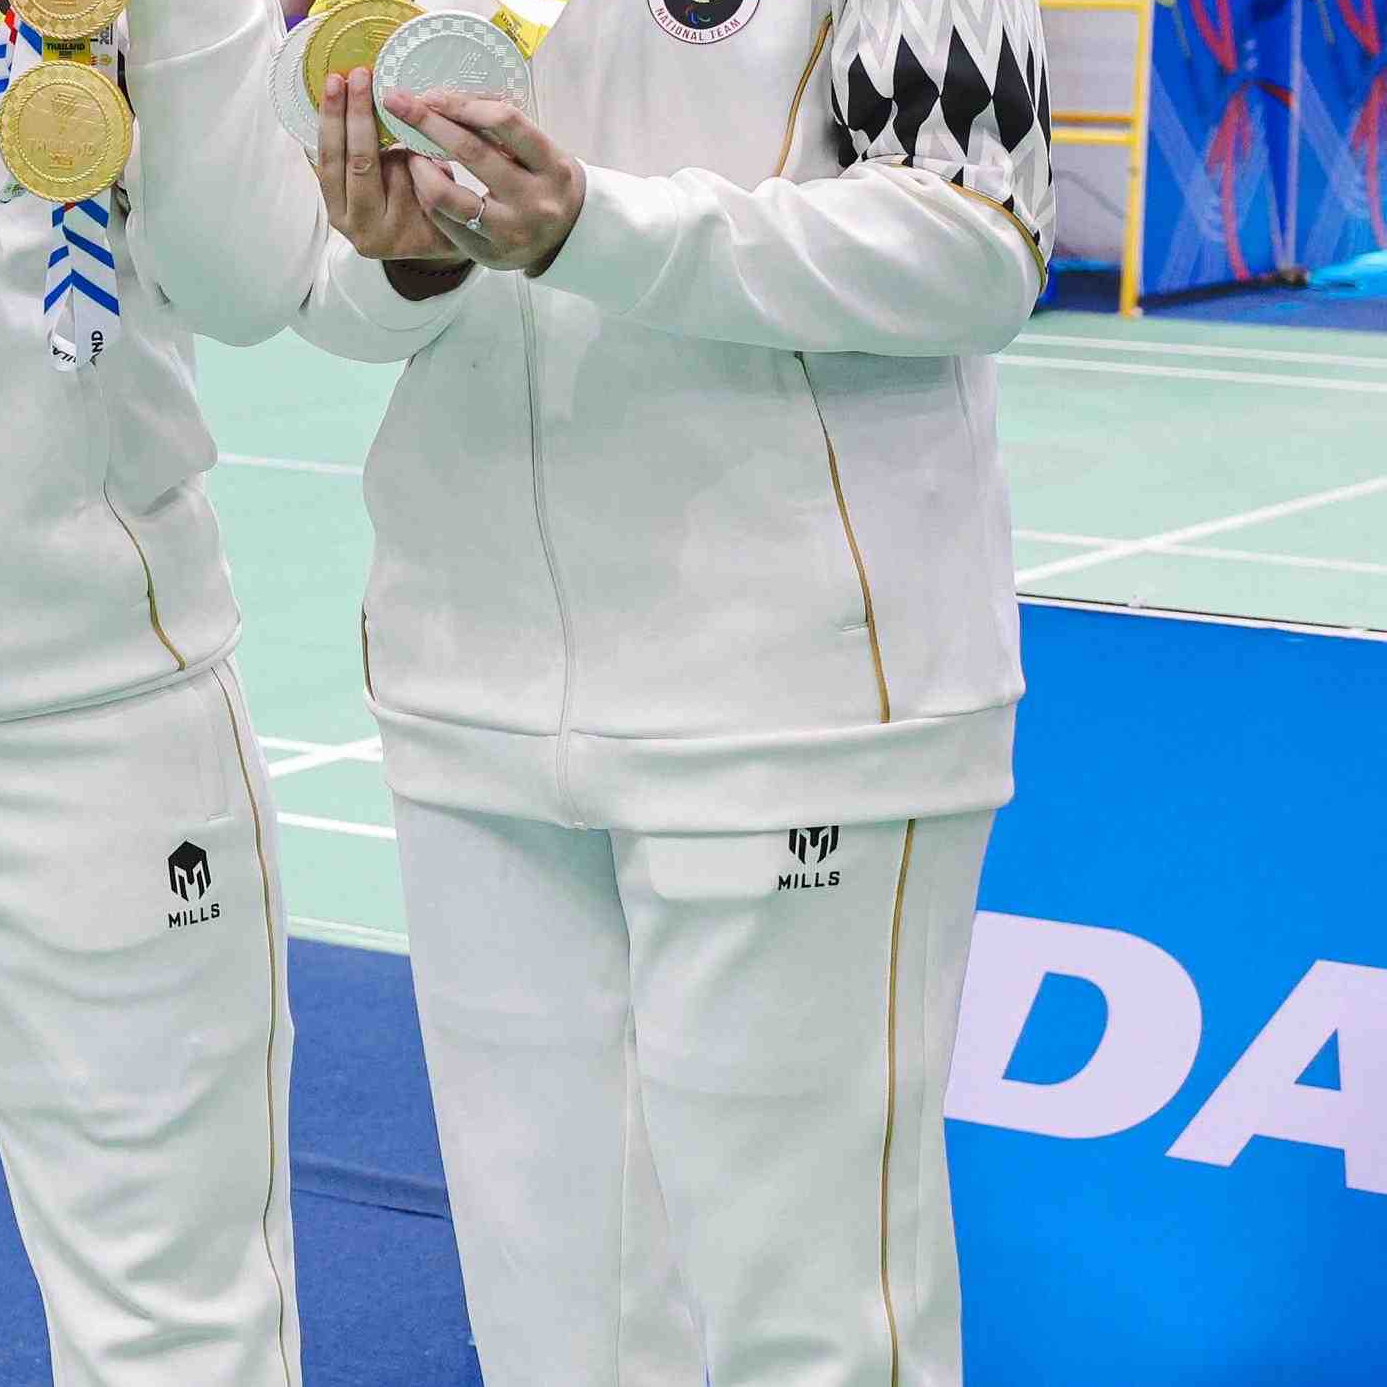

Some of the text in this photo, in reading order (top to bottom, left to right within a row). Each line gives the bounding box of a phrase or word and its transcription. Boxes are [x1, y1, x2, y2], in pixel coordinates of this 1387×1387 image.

[655, 7, 741, 41] NATIONAL TEAM
[778, 871, 841, 892] MILLS
[168, 903, 220, 928] MILLS
